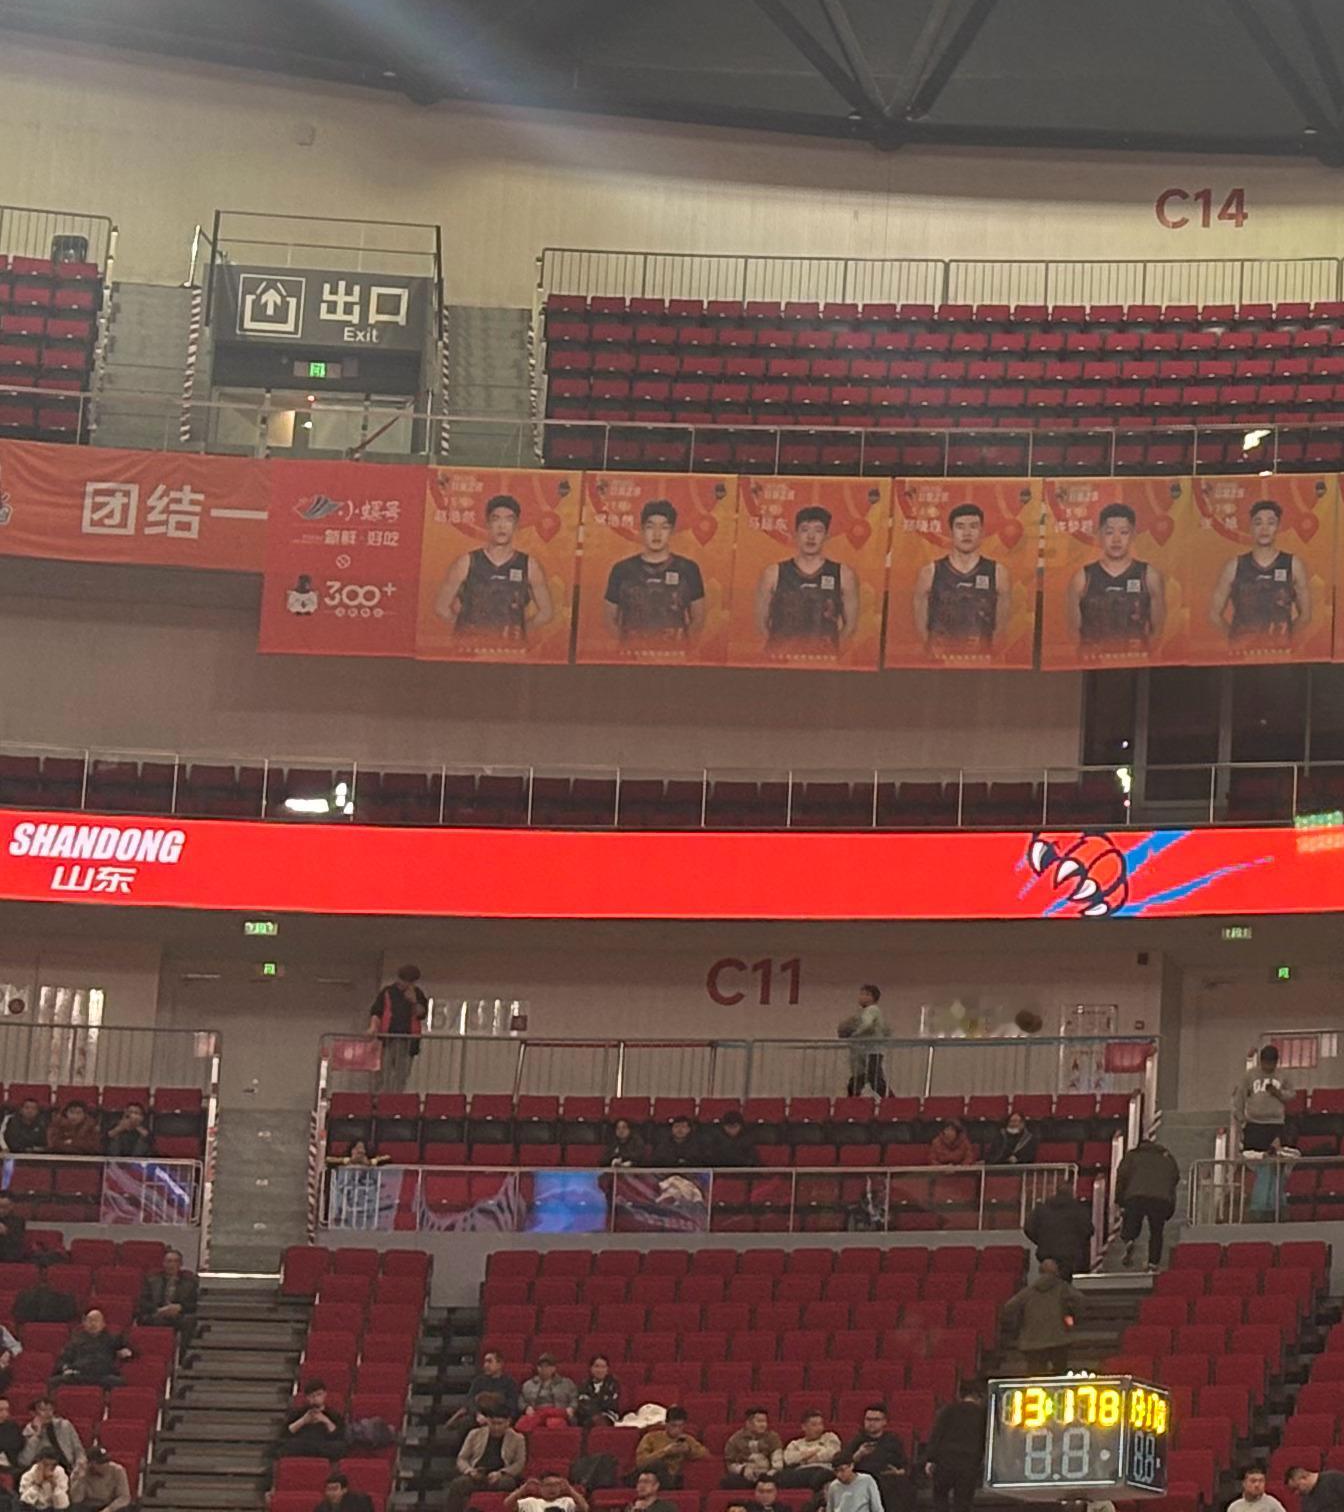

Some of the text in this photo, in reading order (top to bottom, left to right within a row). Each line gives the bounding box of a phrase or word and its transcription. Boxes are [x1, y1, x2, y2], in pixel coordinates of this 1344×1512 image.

[1155, 188, 1248, 229] C14
[320, 281, 408, 325] 出口
[344, 328, 379, 342] Exit
[82, 482, 268, 538] 团结一
[324, 581, 397, 606] 300+
[10, 823, 186, 864] SHANDONG
[51, 866, 137, 894] 山东
[706, 957, 802, 1006] C11
